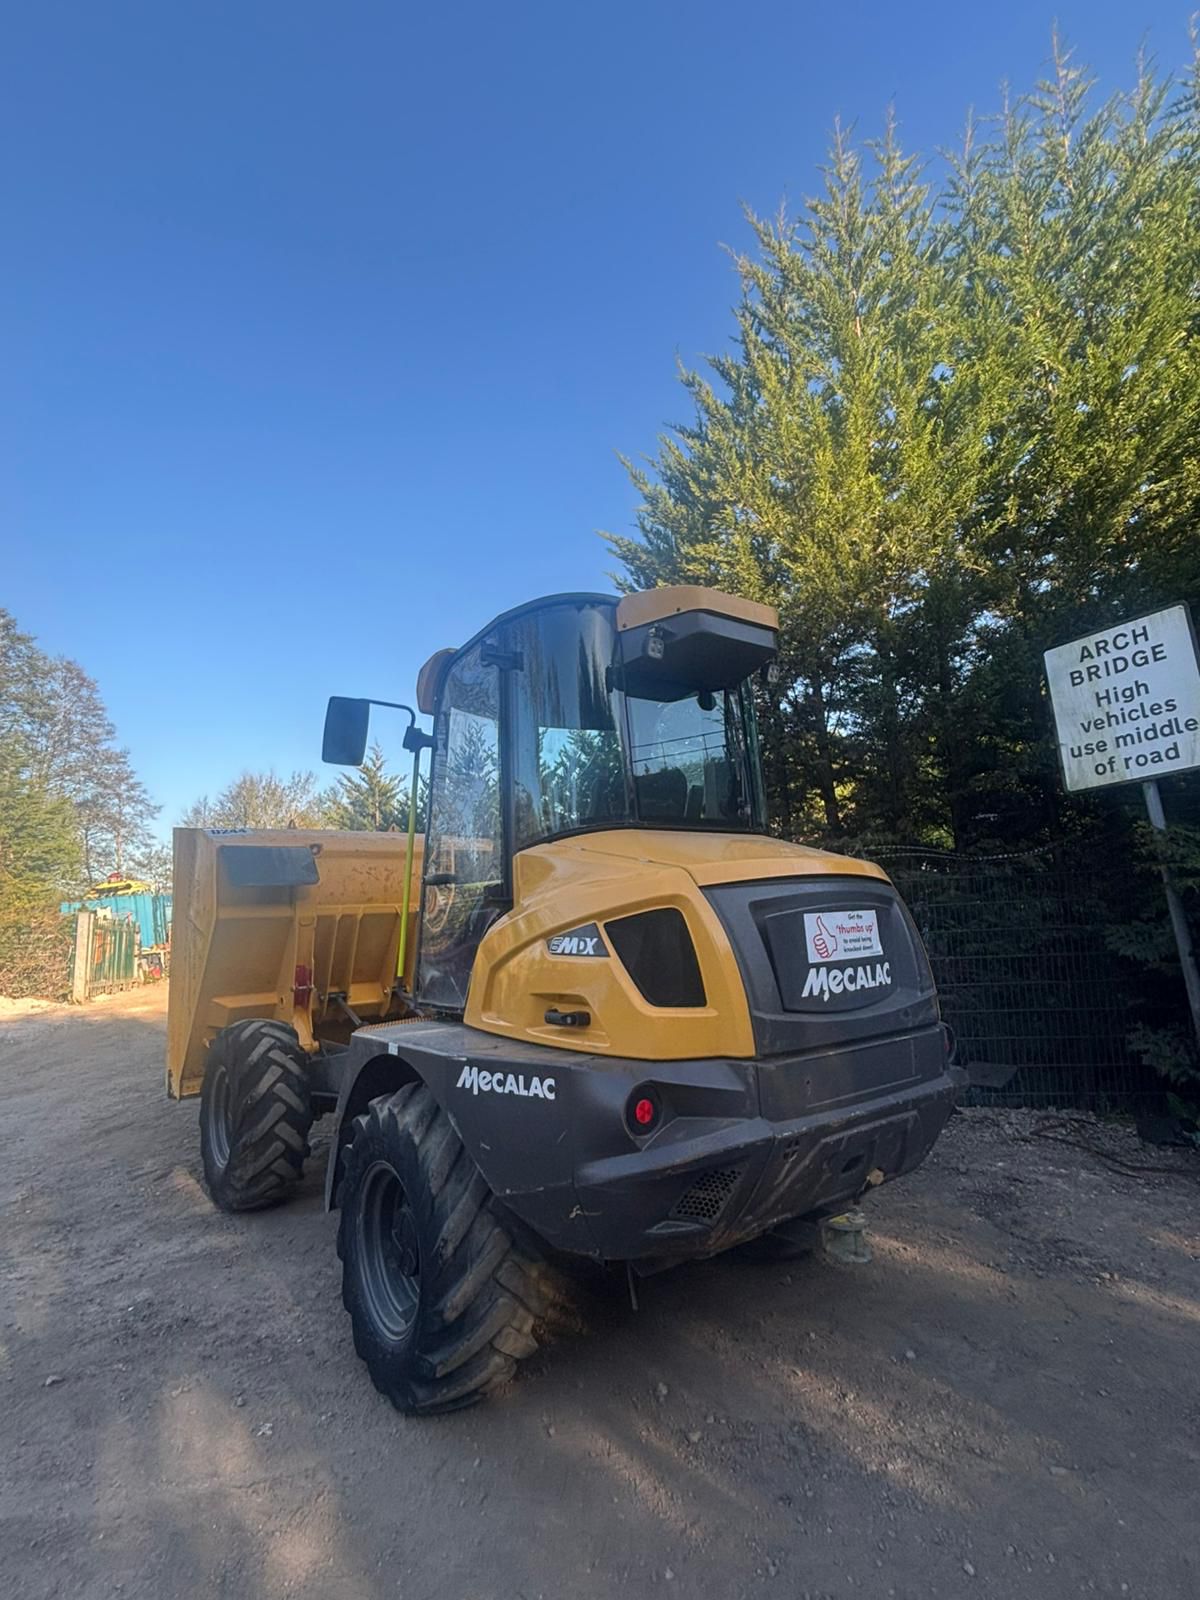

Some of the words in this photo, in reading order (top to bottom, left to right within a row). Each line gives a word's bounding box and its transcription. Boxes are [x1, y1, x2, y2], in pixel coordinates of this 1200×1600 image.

[1079, 625, 1149, 663] ARCH
[1069, 643, 1167, 687] BRIDGE
[1095, 680, 1150, 707] High
[1080, 698, 1177, 733] vehicles
[1070, 740, 1108, 759] use
[1115, 717, 1199, 749] middle
[1094, 756, 1117, 776] of
[1124, 742, 1180, 770] road
